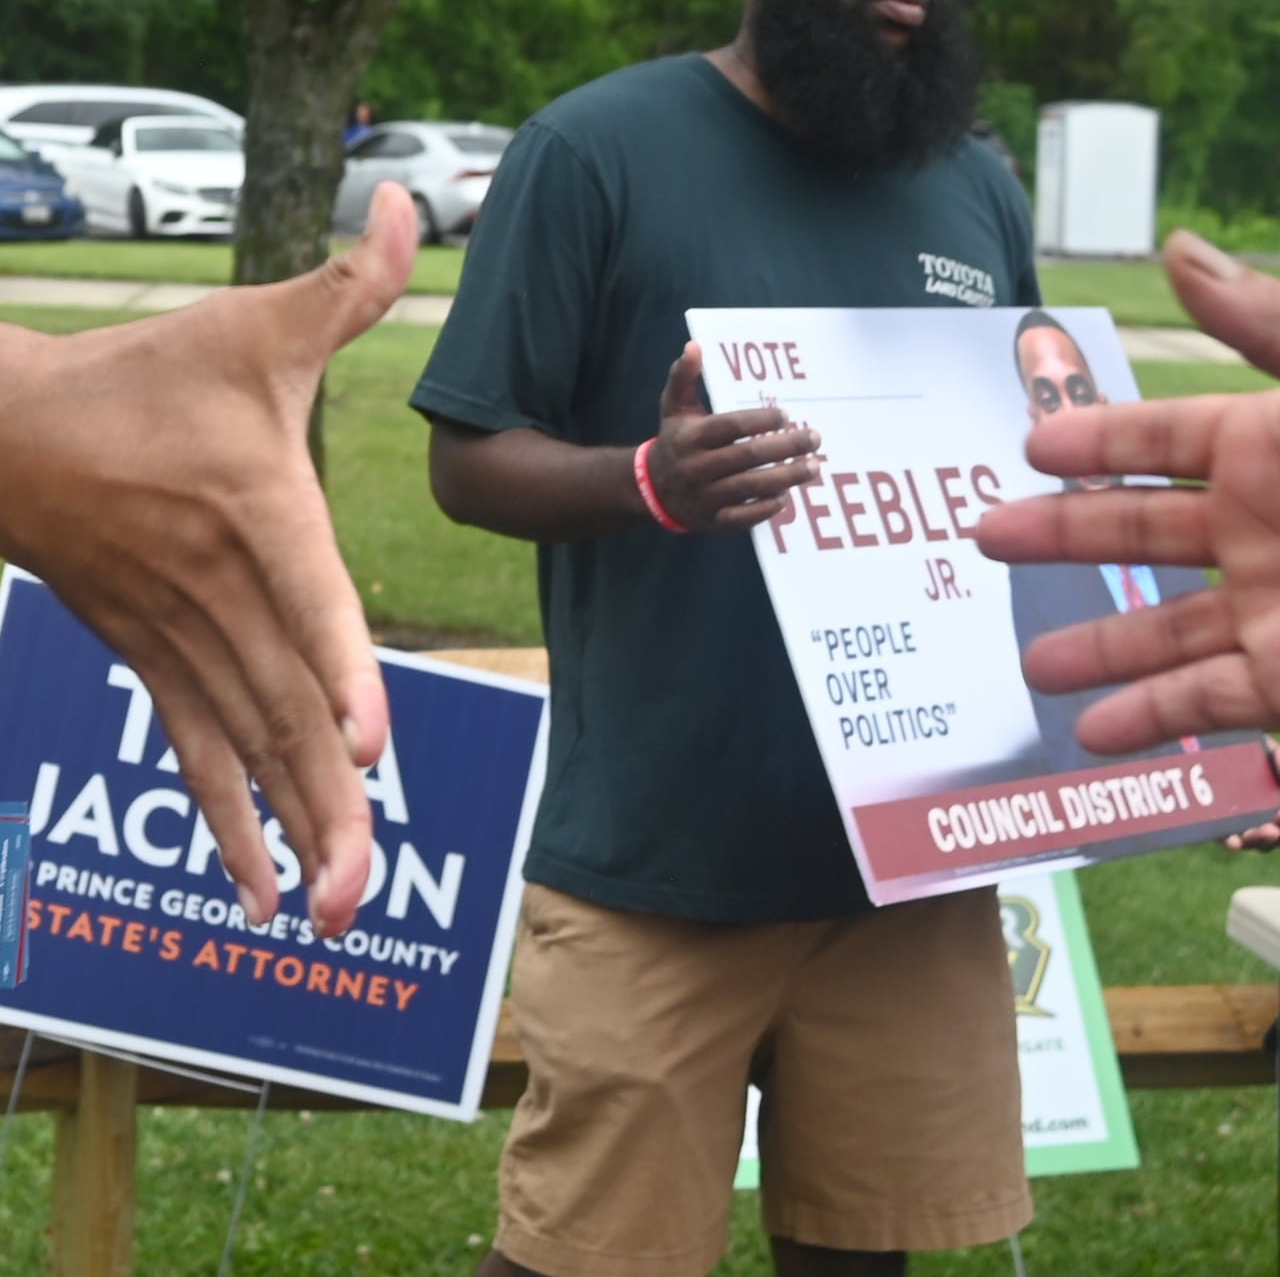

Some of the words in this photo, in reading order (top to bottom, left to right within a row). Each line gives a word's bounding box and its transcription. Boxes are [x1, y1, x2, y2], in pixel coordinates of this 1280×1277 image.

[918, 252, 995, 297] TOYOTA
[719, 341, 807, 382] VOTE
[768, 464, 1006, 554] PEEBLES
[924, 557, 972, 601] JR.
[825, 668, 893, 707] OVER
[926, 789, 1065, 853] COUNCIL
[1057, 768, 1189, 831] DISTRICT
[1188, 764, 1216, 807] 6
[36, 860, 154, 910] PRINCE
[26, 899, 183, 961] STATE'S
[193, 941, 419, 1012] ATTORNEY
